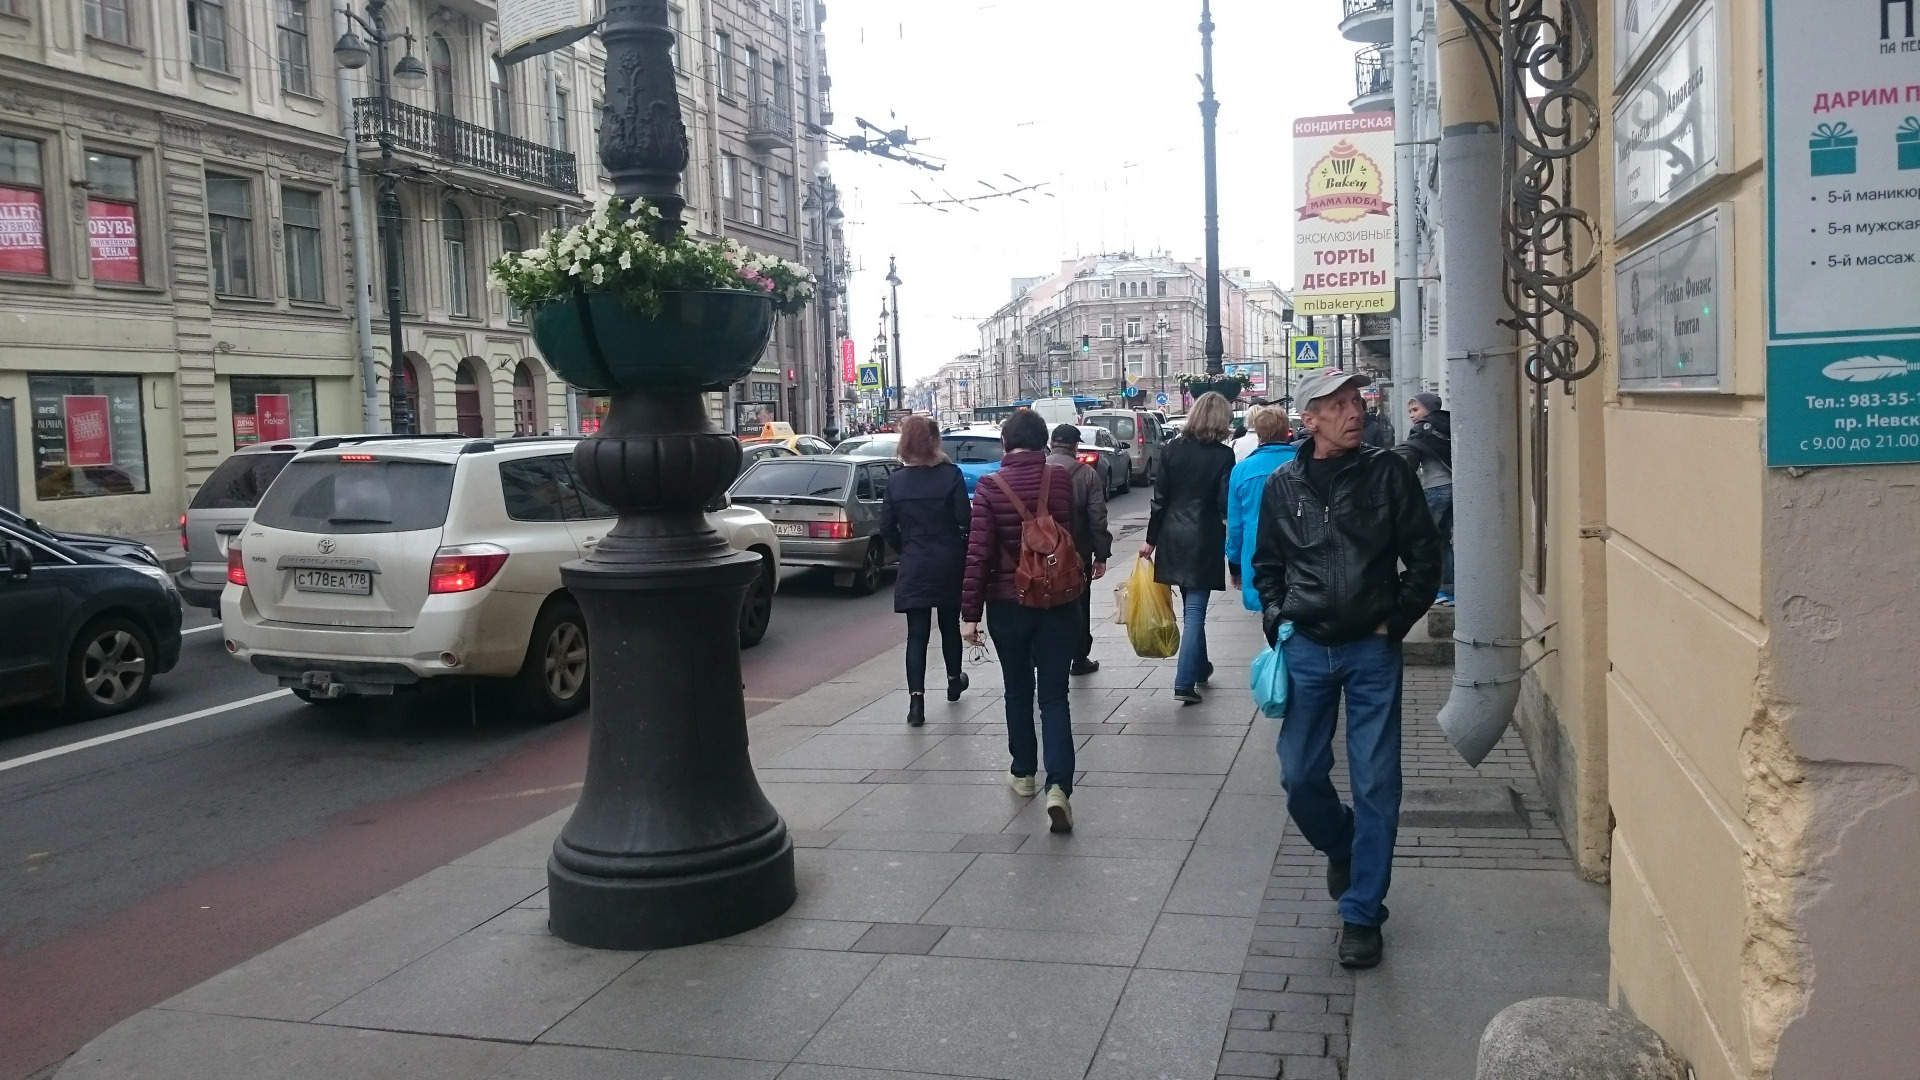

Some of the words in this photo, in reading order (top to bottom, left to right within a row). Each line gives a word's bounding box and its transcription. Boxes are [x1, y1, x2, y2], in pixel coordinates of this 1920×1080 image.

[1880, 42, 1896, 54] НА
[1901, 40, 1920, 52] НЕ
[1666, 65, 1704, 118] Авиакасса
[1813, 87, 1898, 114] ДАРИМ
[1295, 116, 1393, 134] КОНДИТЕРСКАЯ
[1319, 175, 1367, 191] Bakery
[1310, 197, 1342, 209] МАМА
[1344, 196, 1378, 207] ЛЮБА
[1828, 190, 1852, 203] 5-й
[1856, 188, 1920, 201] маникю
[88, 220, 133, 235] ОБУВЬ
[1828, 222, 1851, 235] 5-я
[1296, 228, 1392, 244] ЭКСКЛЮЗИВНЫЕ
[99, 247, 130, 259] ЦЕНАМ
[1314, 248, 1375, 266] ТОРТЫ
[1828, 254, 1852, 267] 5-й
[1856, 253, 1915, 266] массаж
[1303, 270, 1386, 290] ДЕСЕРТЫ
[1663, 281, 1684, 306] Глобал
[1685, 275, 1712, 299] Финанс
[1304, 297, 1384, 314] mlbakery.net
[1674, 314, 1700, 337] Капитал
[1805, 395, 1845, 409] Тел.:
[236, 420, 255, 428] ДЕНЬ
[1835, 417, 1862, 431] пр.
[1813, 437, 1845, 450] 9.00
[1850, 438, 1870, 451] до
[1875, 434, 1919, 448] 21.00
[347, 573, 366, 585] 178
